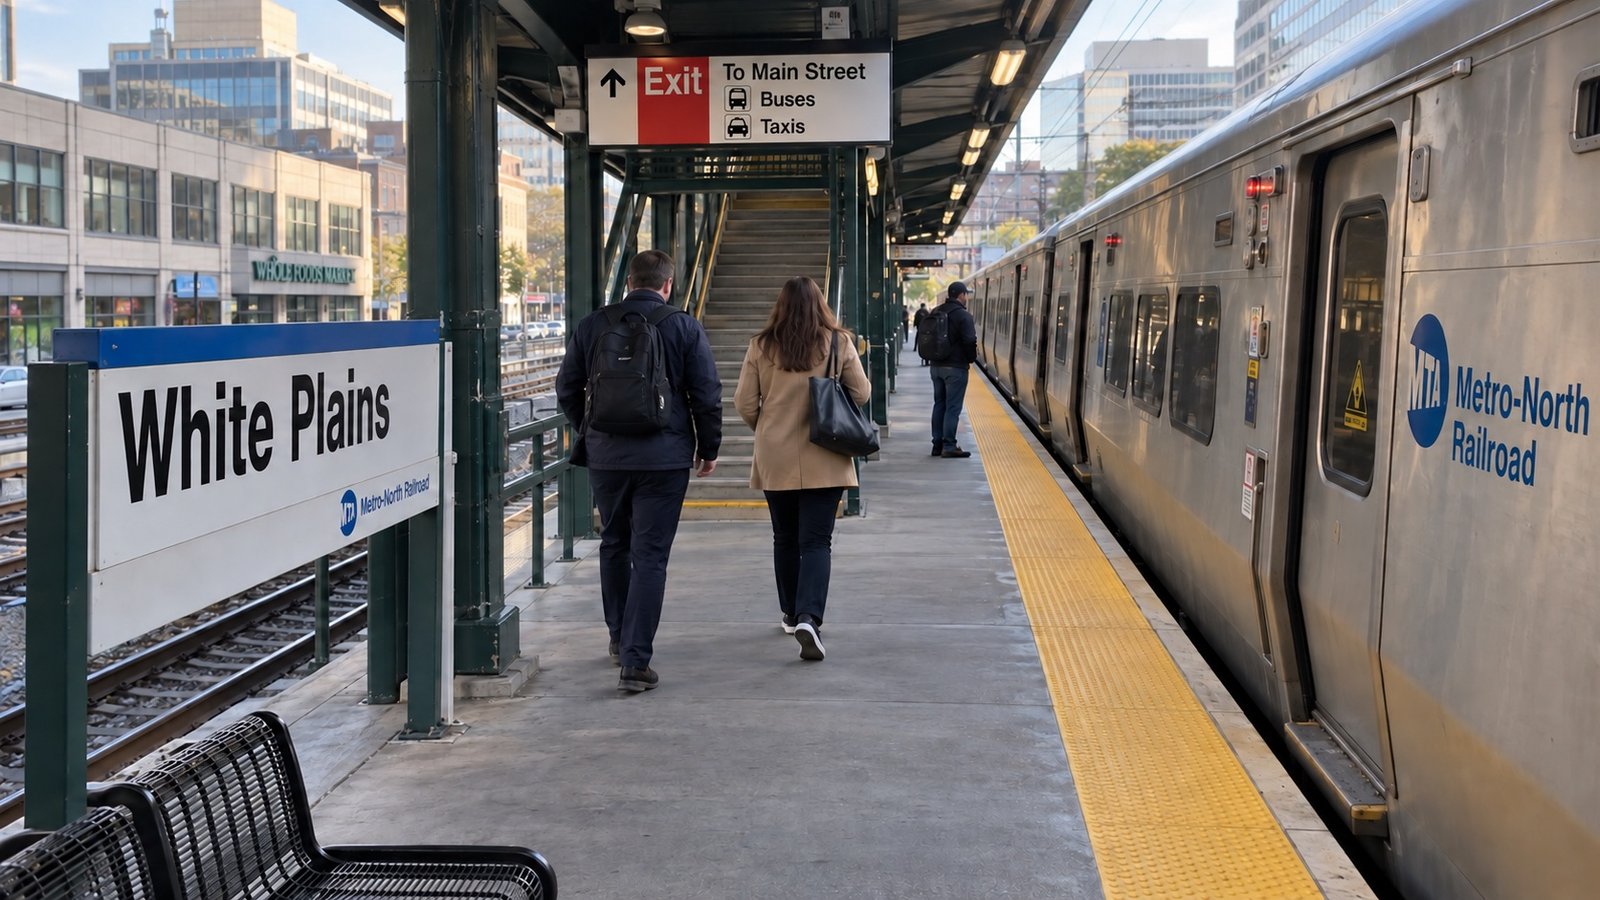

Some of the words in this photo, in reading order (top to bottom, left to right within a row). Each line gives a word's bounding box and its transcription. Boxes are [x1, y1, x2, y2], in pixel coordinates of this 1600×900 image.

[644, 66, 703, 95] Exit
[722, 63, 745, 80] To
[751, 62, 799, 80] Main
[805, 62, 866, 80] Street
[760, 91, 816, 107] Buses
[760, 118, 806, 134] Taxis
[252, 257, 293, 282] WHOLE
[293, 263, 322, 284] FOODS
[1455, 365, 1590, 436] Metro-North
[118, 380, 273, 504] White
[291, 368, 390, 462] Plains
[1452, 420, 1537, 487] Railroad
[360, 484, 403, 516] Metro-North
[404, 473, 430, 499] Railroad
